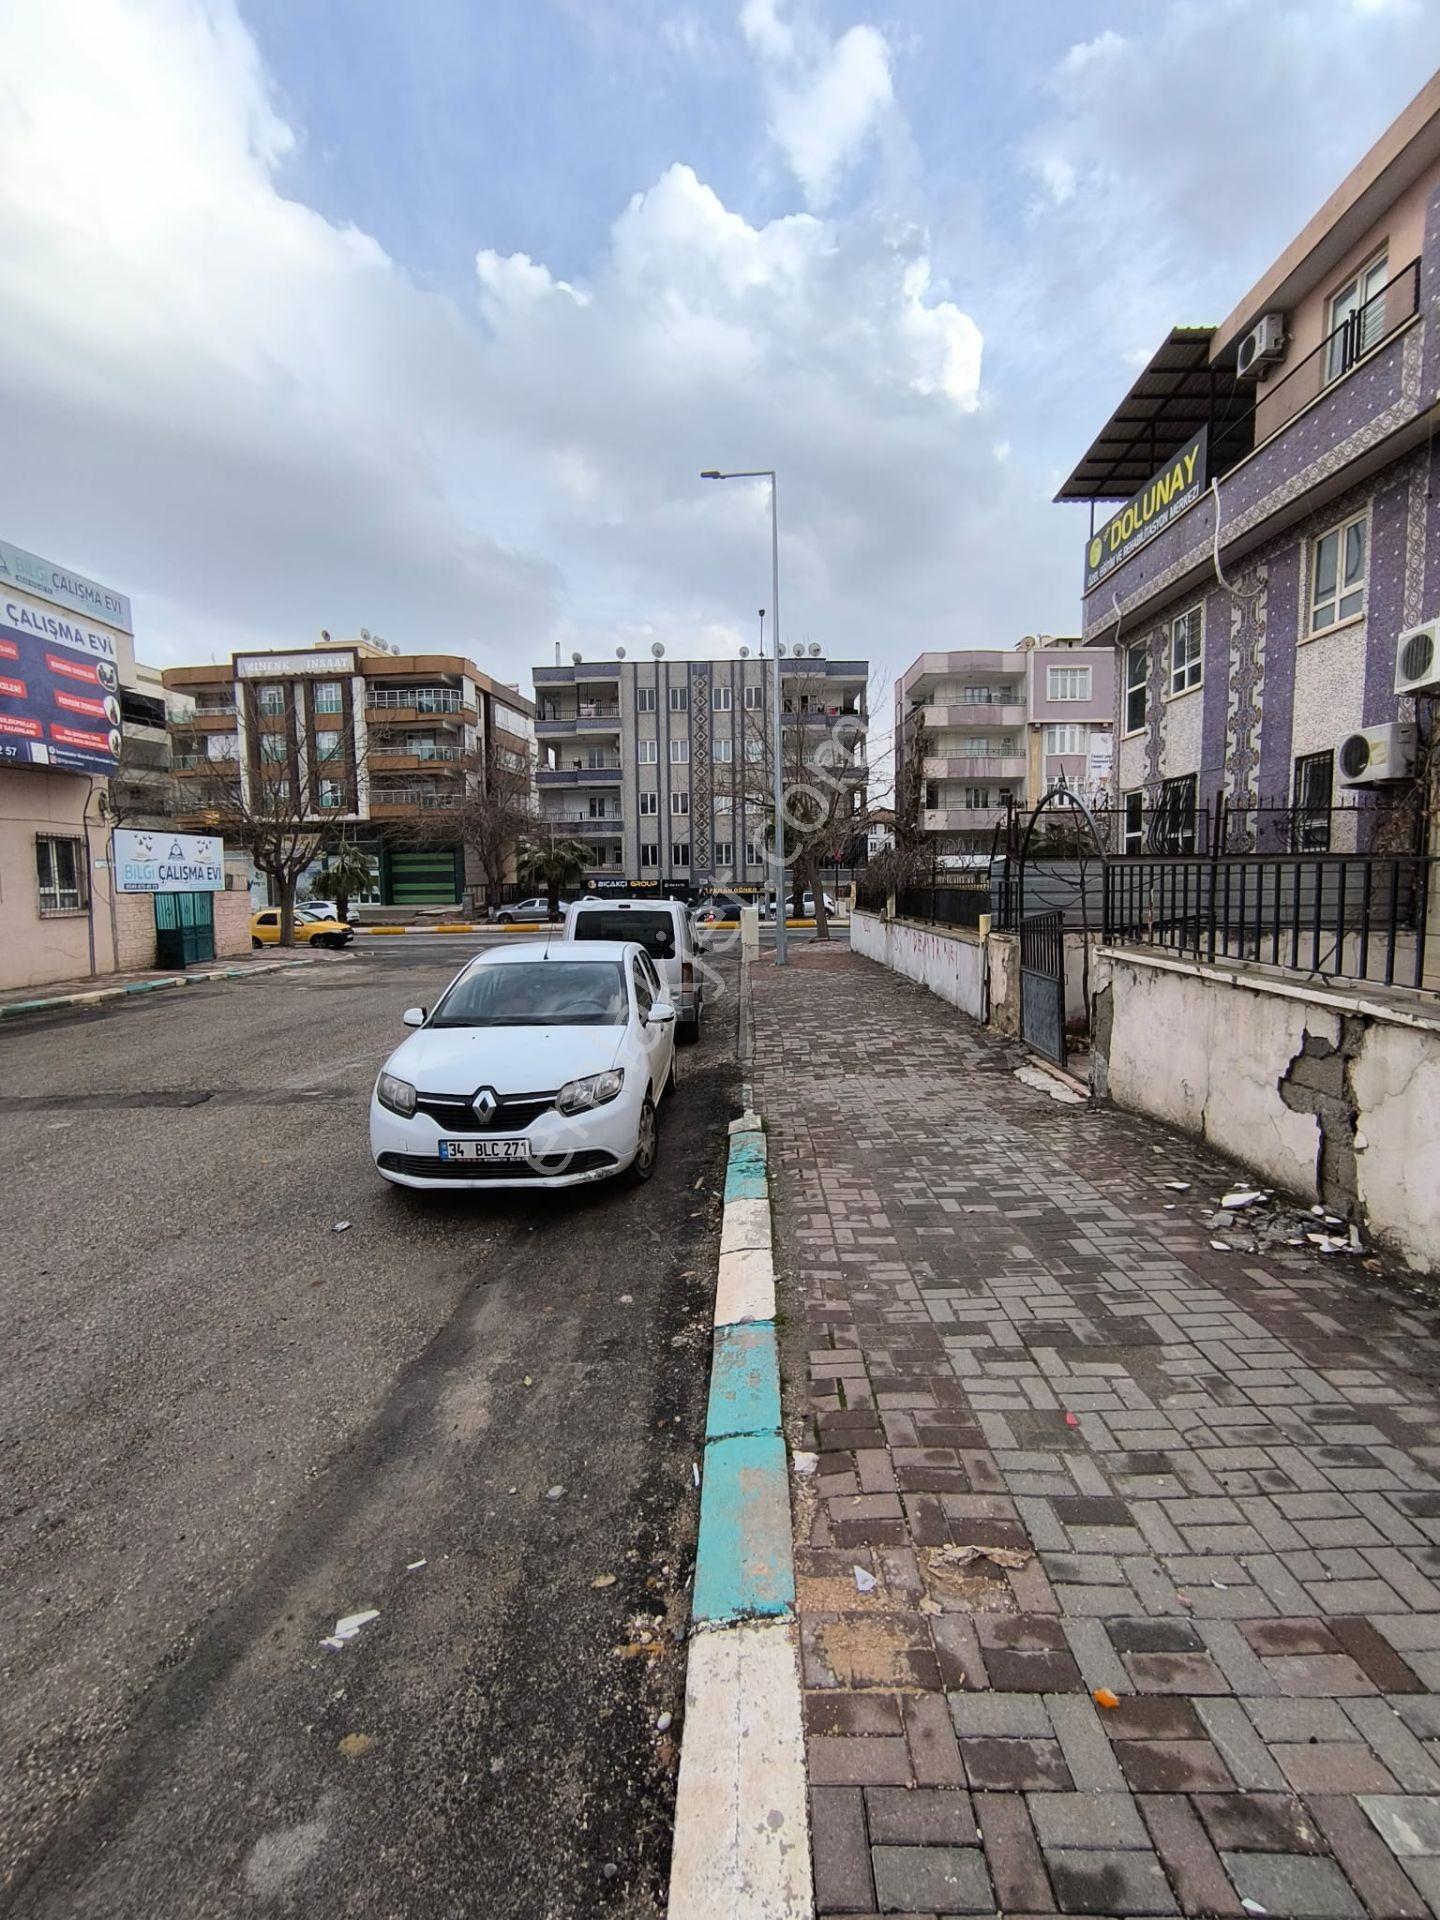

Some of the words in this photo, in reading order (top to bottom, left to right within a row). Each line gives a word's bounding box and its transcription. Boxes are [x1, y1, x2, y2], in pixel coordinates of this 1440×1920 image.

[1110, 444, 1200, 552] DOLUNAY
[6, 603, 85, 646] ÇALIŞMA
[88, 632, 114, 655] EVİ
[158, 865, 204, 884] ÇALIŞMA
[448, 1143, 464, 1157] 34
[475, 1142, 500, 1157] BLC
[503, 1142, 527, 1156] 271
